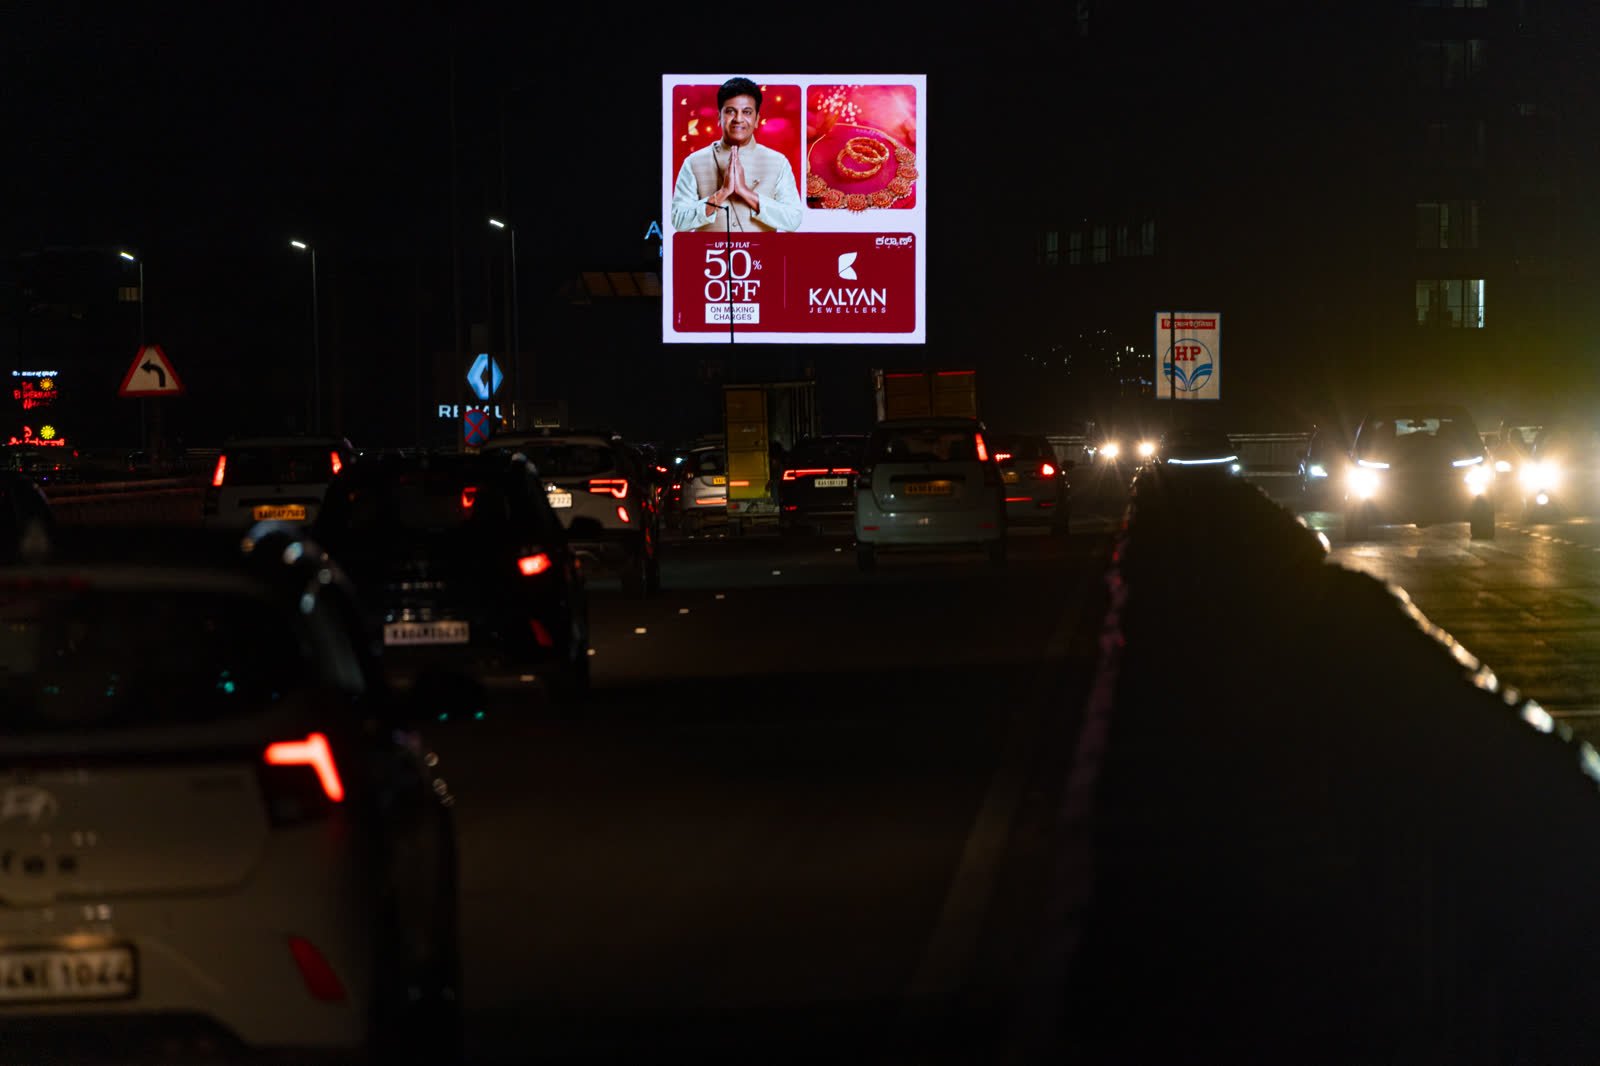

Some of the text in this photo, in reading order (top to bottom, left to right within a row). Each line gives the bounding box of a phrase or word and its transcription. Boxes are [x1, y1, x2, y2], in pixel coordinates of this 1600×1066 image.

[704, 280, 760, 302] OFF
[809, 288, 887, 306] KALYAN
[1174, 346, 1201, 361] HP
